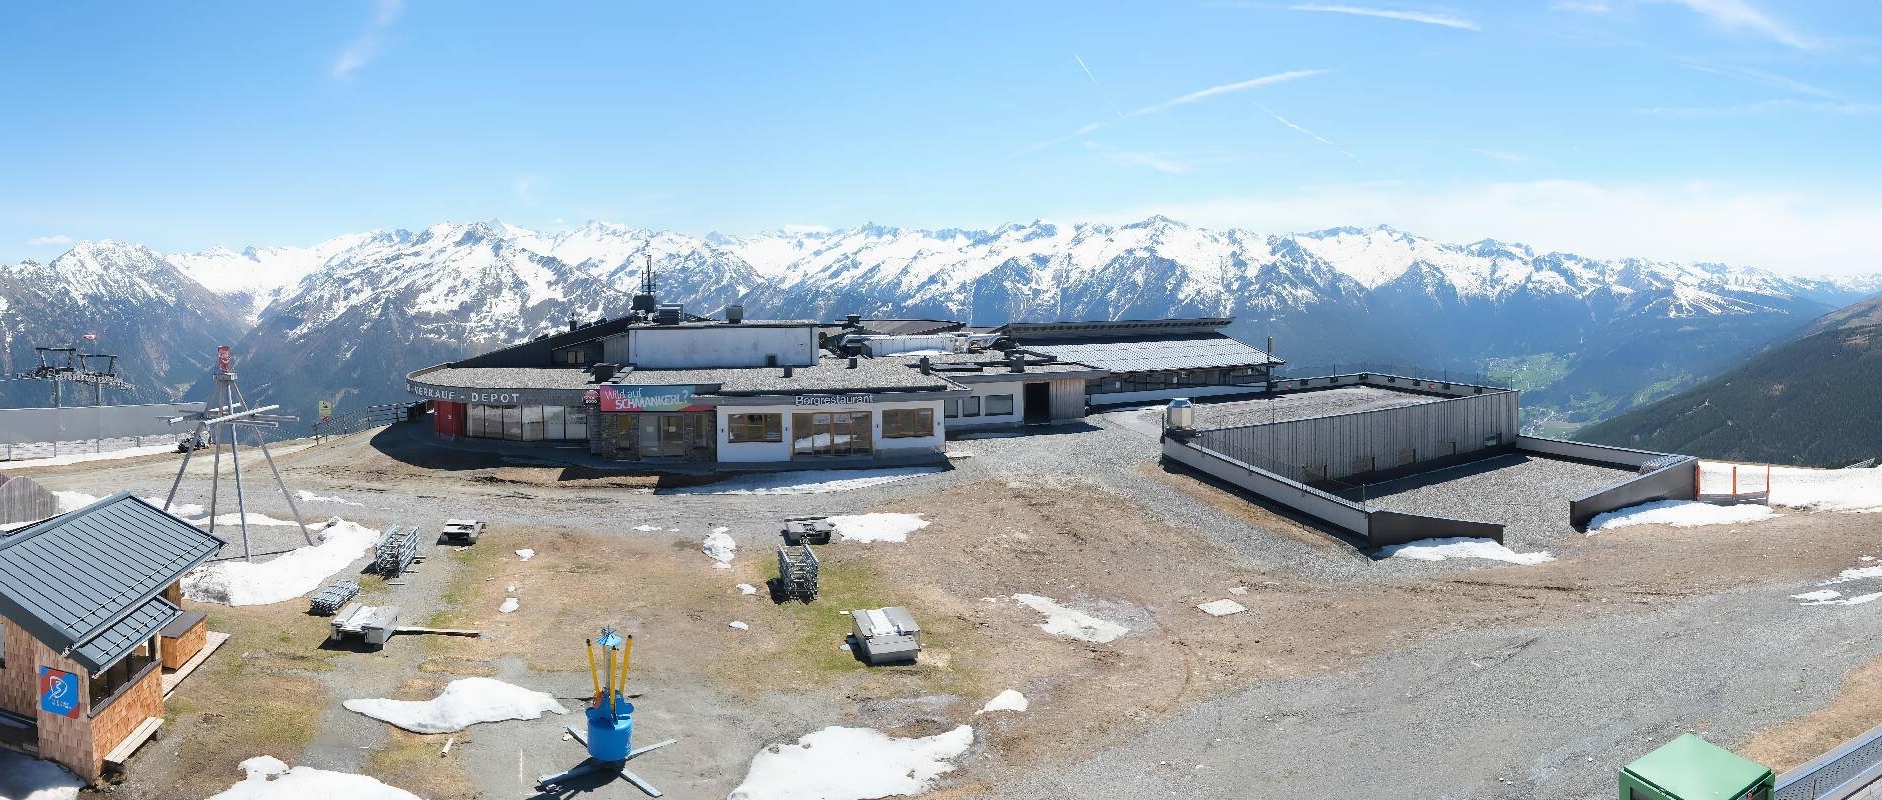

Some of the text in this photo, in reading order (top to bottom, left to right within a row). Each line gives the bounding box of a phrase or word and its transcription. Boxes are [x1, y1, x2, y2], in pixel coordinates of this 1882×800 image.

[414, 386, 455, 400] VERKAUF
[471, 392, 520, 403] DEPOT
[604, 389, 626, 401] Wild
[795, 394, 874, 406] Bergrestaurant
